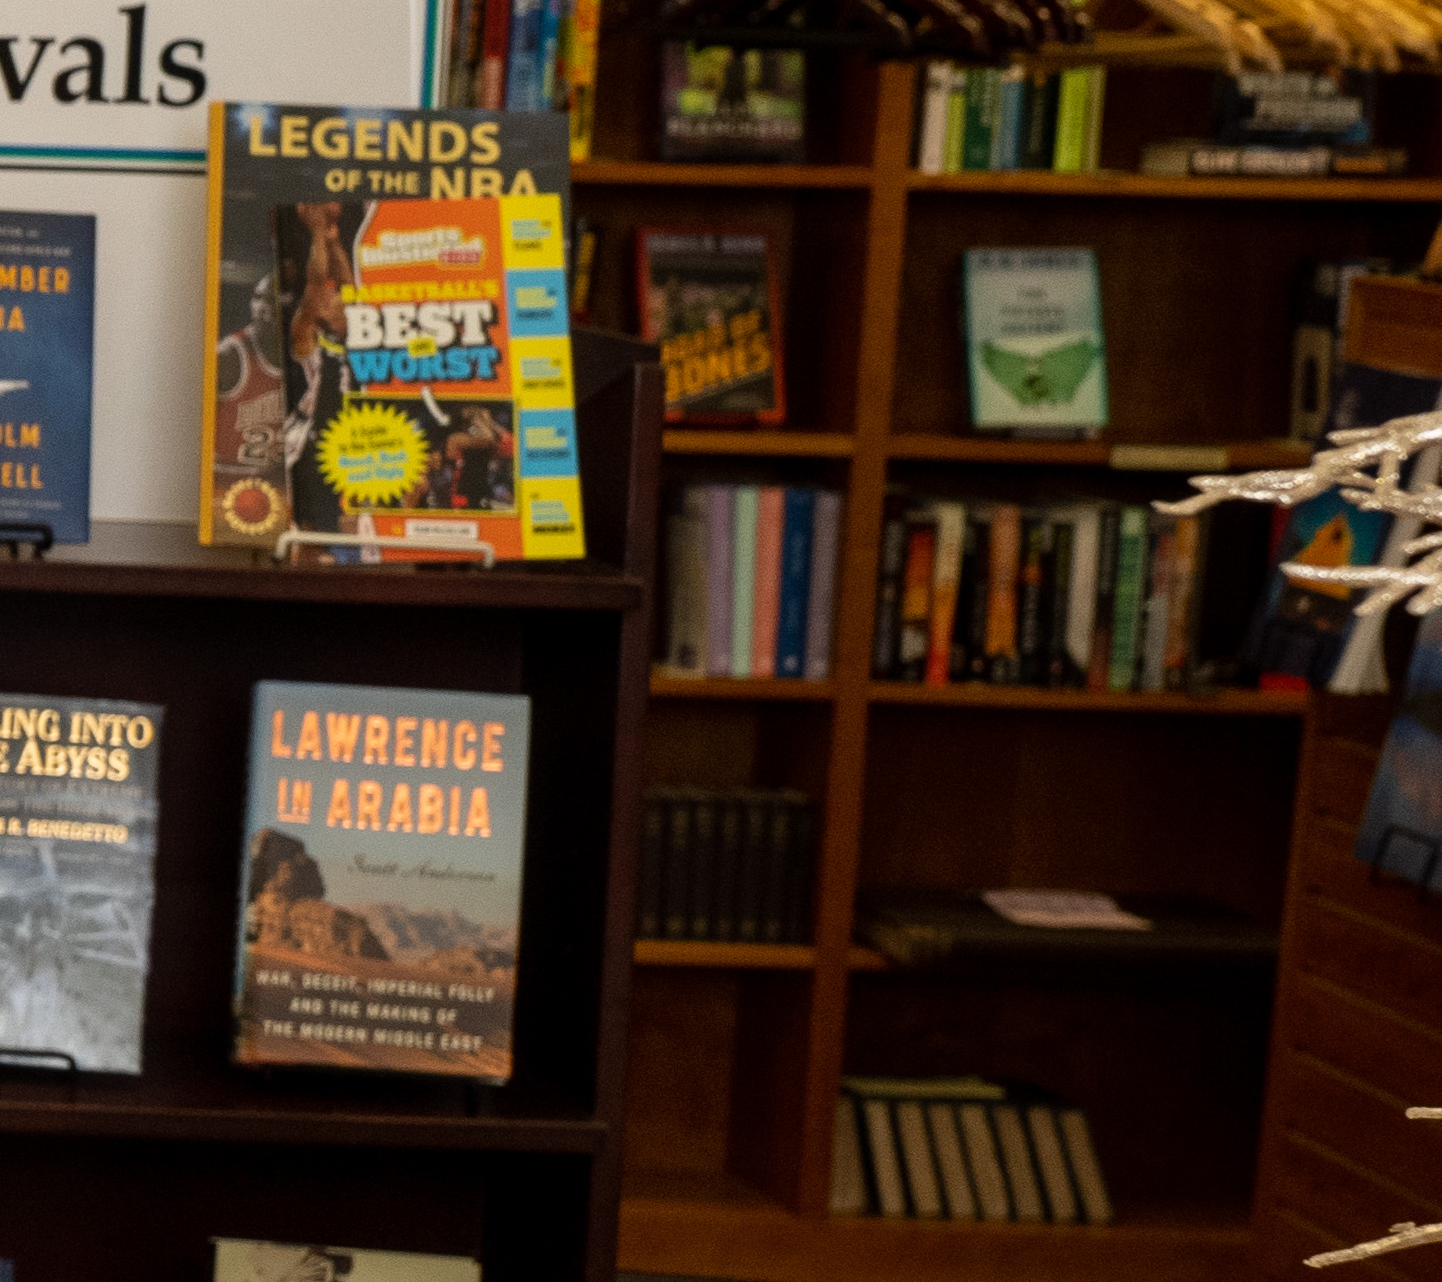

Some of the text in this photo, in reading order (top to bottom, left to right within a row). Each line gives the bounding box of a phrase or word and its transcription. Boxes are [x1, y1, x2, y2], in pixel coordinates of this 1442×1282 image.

[249, 116, 501, 164] LEGENDS
[325, 167, 539, 200] OF THE NBA
[345, 301, 495, 350] BEST
[349, 348, 498, 382] WORST
[68, 712, 155, 750] INTO
[272, 709, 506, 773] LAWRENCE
[14, 739, 132, 782] ABYSS
[277, 778, 493, 839] IN ARABIA
[301, 971, 495, 1004] DECEIT, IMPERIAL FOLLY
[290, 997, 430, 1024] AND THE MAKING
[263, 1019, 484, 1053] THE MODERN MIDDLE EAST
